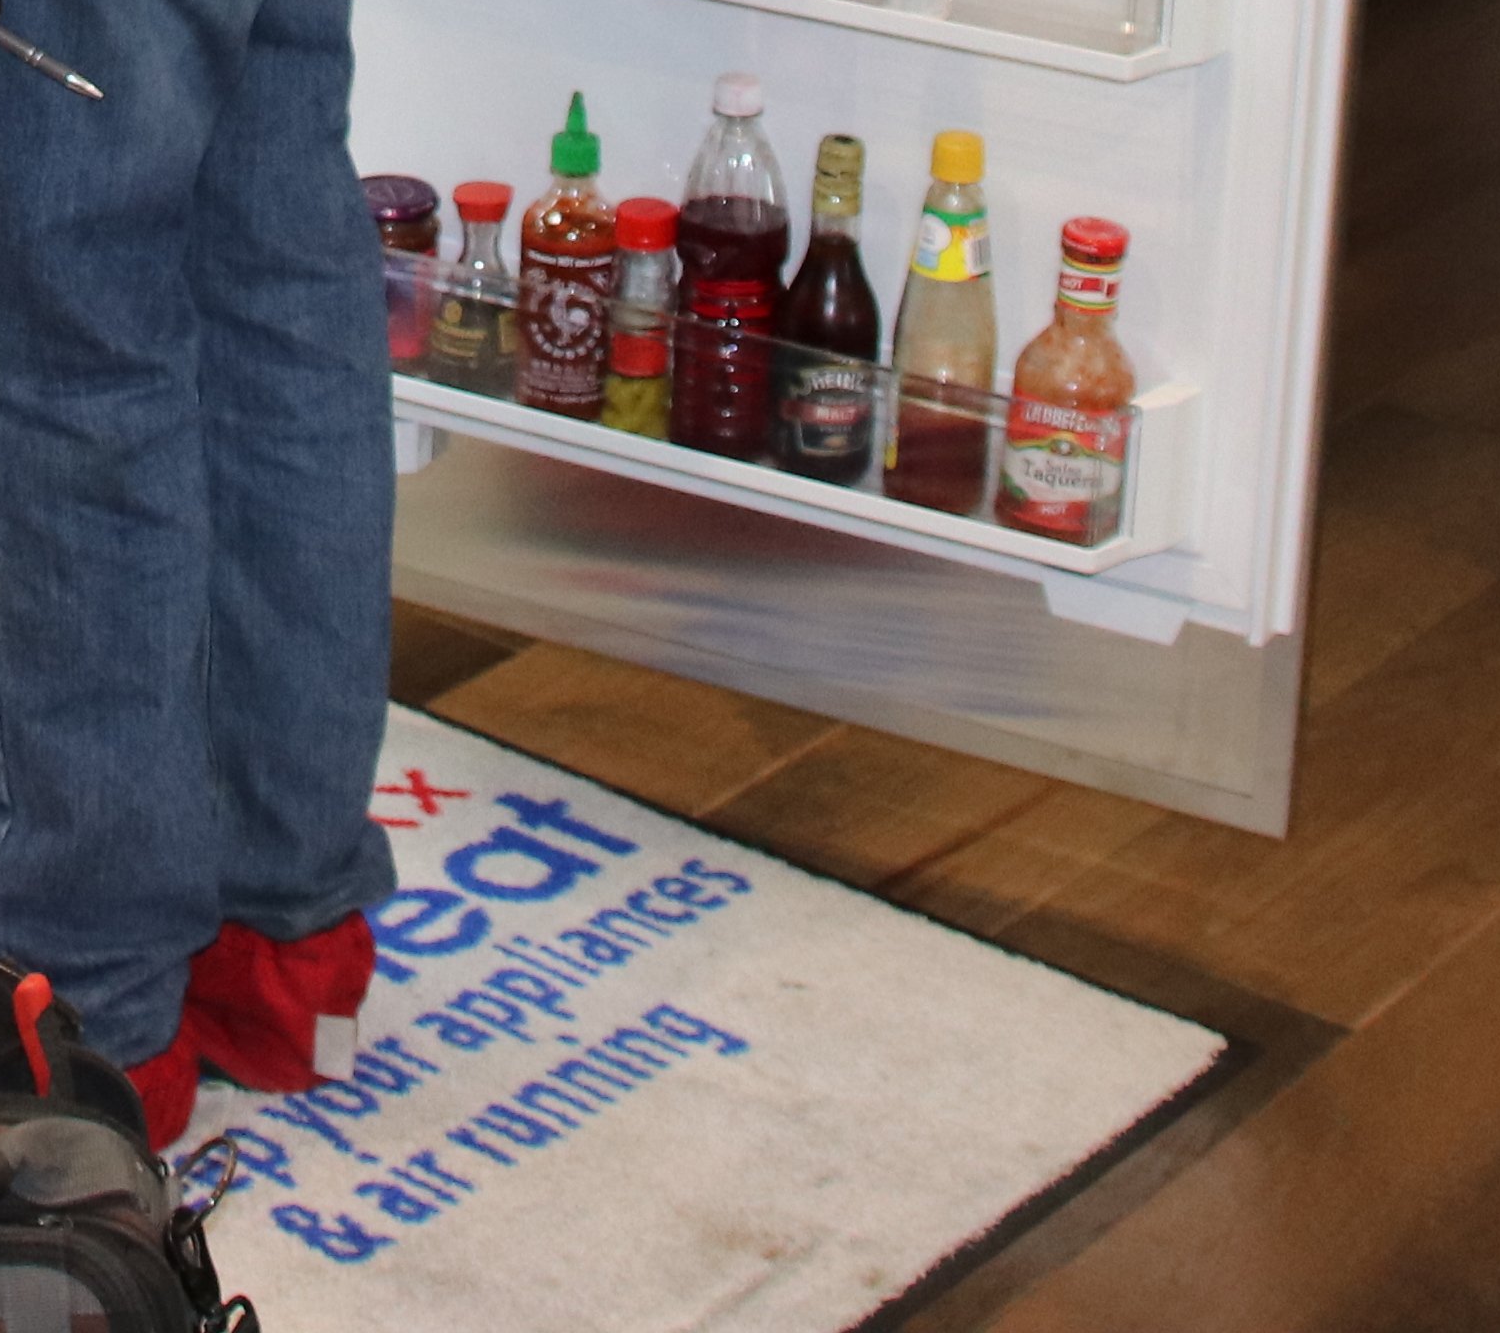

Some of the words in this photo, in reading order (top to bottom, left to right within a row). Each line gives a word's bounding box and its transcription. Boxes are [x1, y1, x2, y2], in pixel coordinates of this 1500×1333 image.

[259, 1035, 441, 1153] your
[414, 858, 754, 1053] appliances
[362, 792, 639, 984] eat
[271, 1203, 397, 1263] &
[353, 1149, 474, 1225] air
[446, 1003, 750, 1167] running
